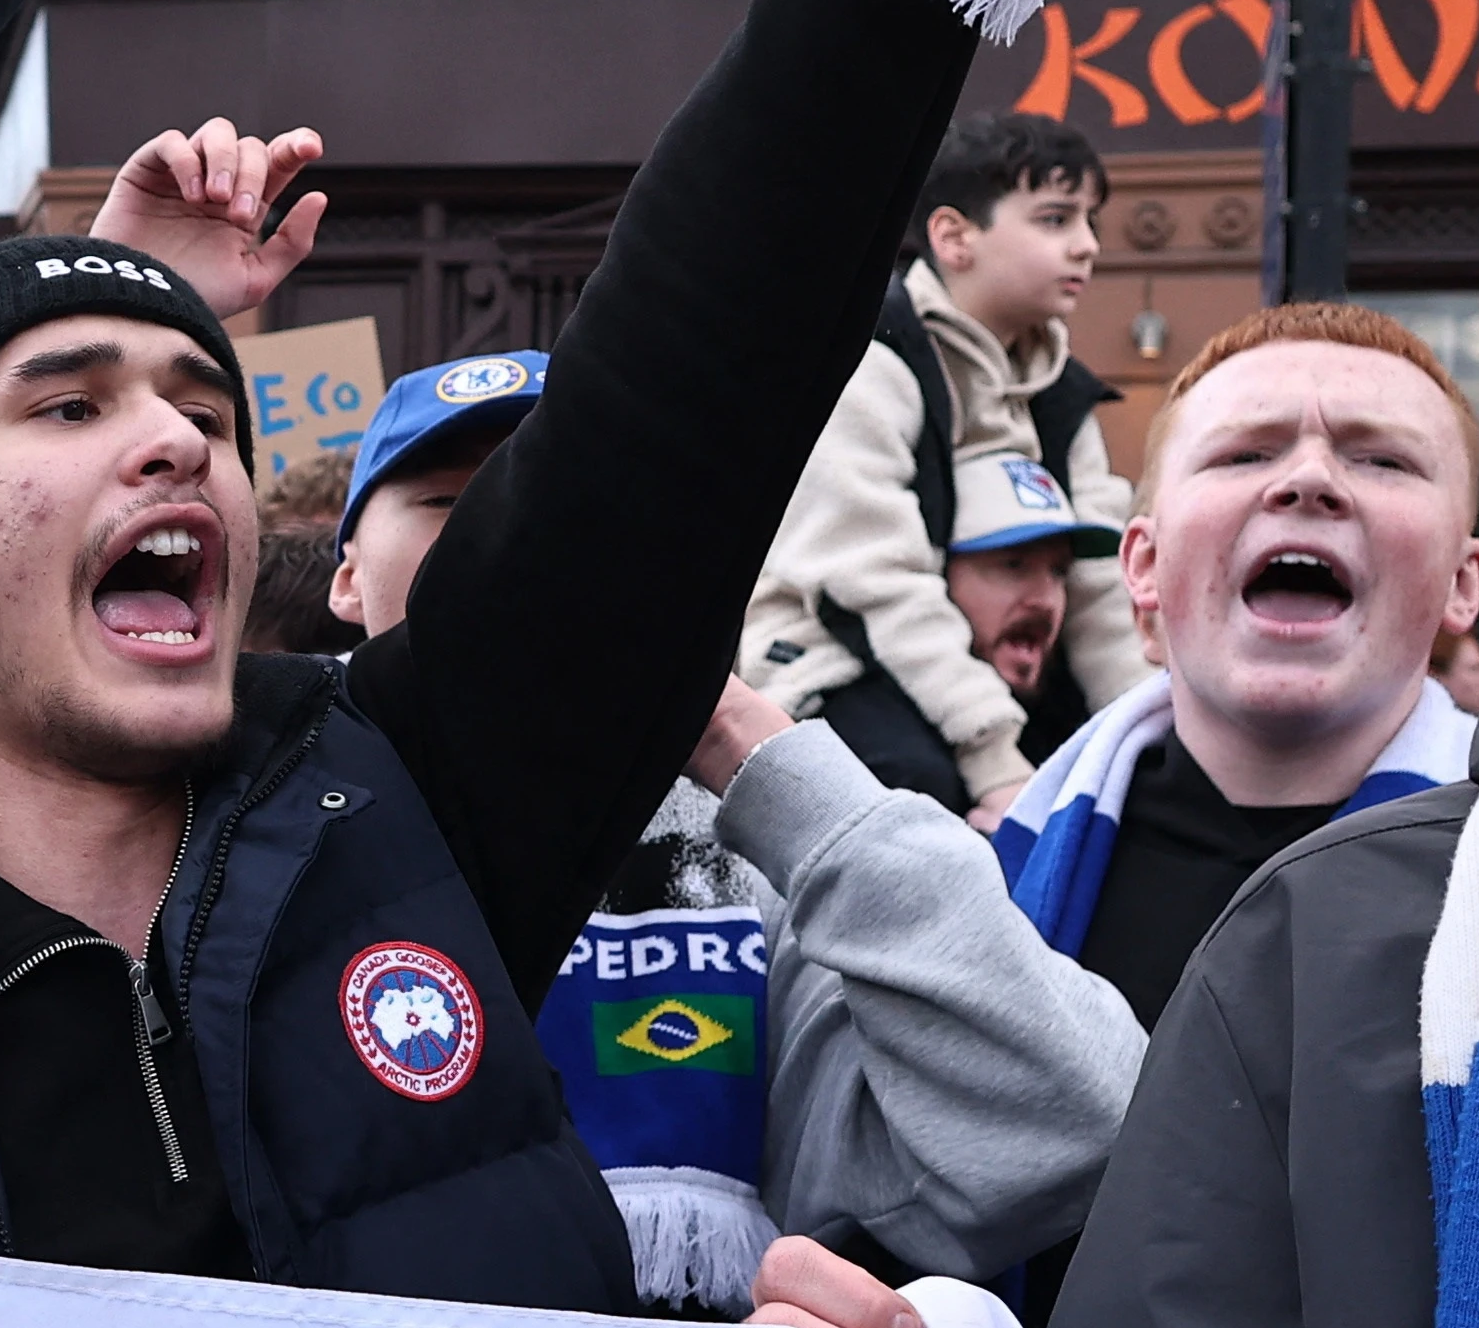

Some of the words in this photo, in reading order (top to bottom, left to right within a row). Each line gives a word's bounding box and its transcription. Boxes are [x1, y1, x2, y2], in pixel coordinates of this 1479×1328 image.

[35, 255, 172, 291] BOSS
[352, 954, 392, 989] CANADA
[377, 1061, 421, 1092] ARCTIC
[425, 1044, 472, 1092] PROGRAM
